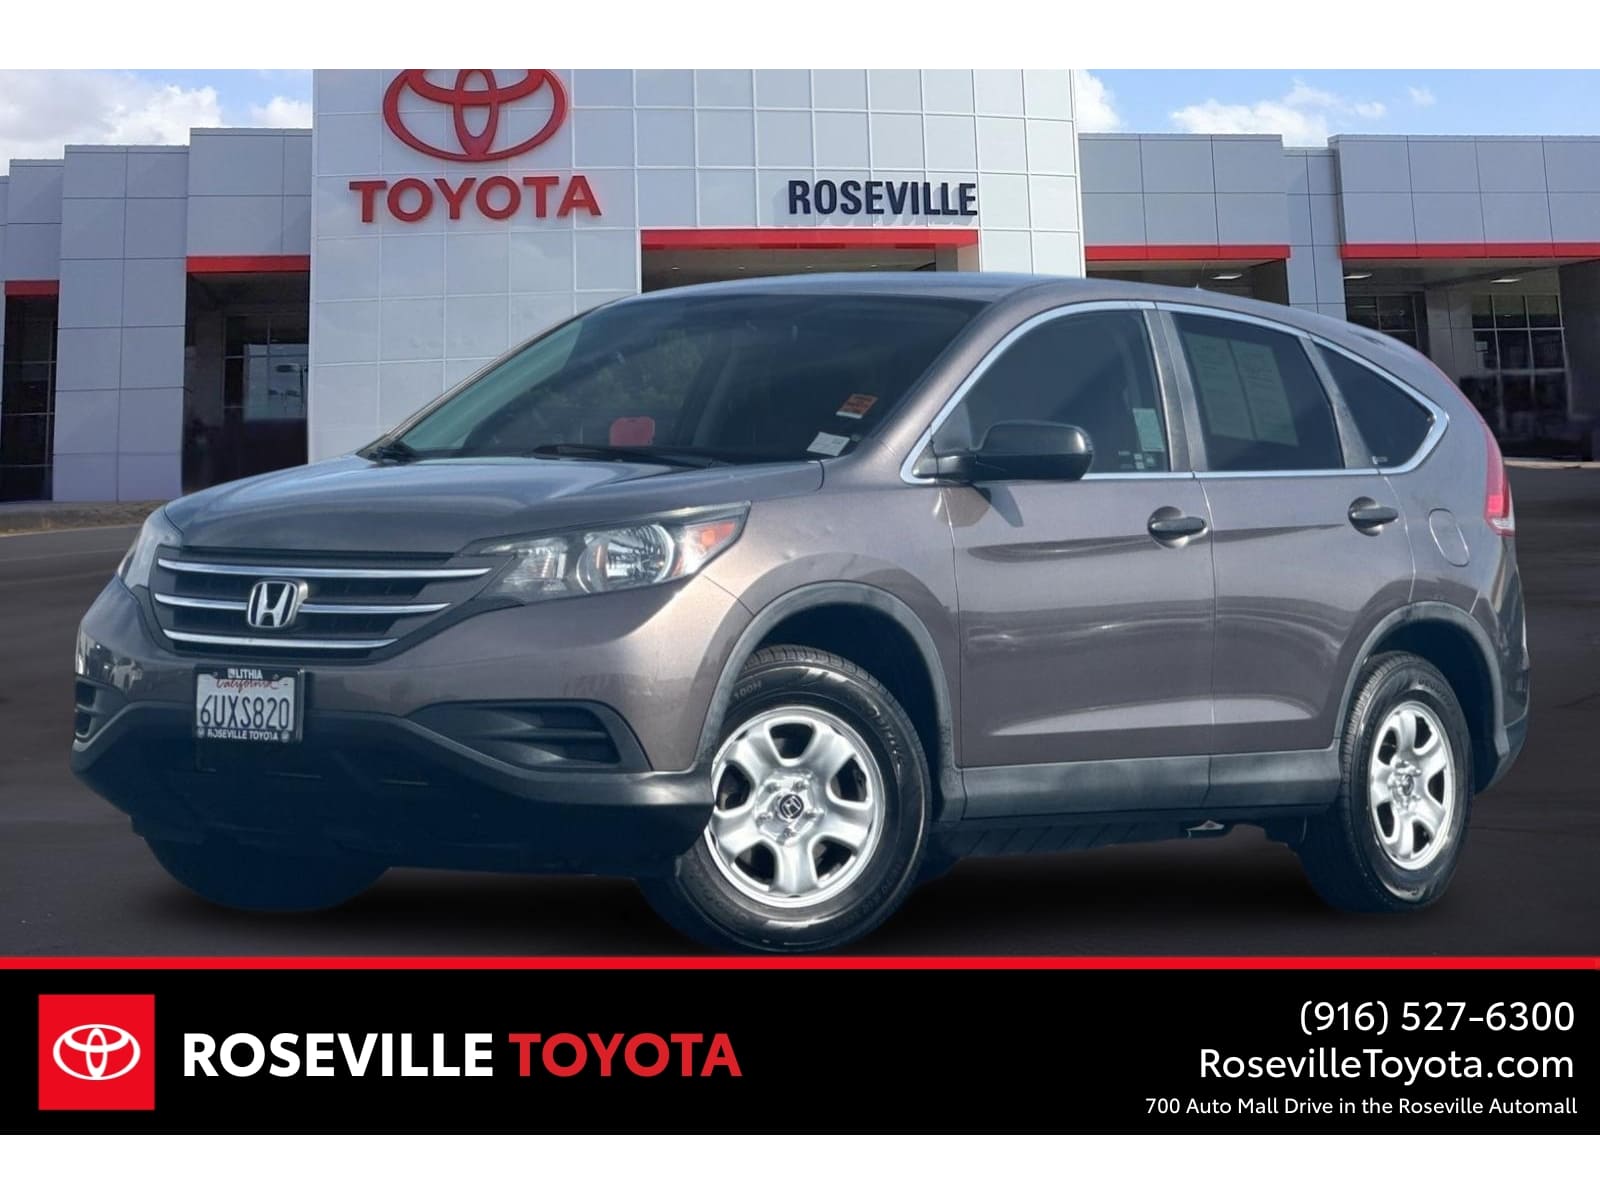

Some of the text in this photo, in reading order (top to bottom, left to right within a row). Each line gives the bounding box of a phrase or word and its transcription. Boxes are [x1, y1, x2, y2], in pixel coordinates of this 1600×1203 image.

[349, 175, 602, 223] TOYOTA
[788, 179, 978, 217] ROSEVILLE
[236, 669, 263, 680] LITHIA
[200, 694, 290, 729] 6UXS820
[207, 728, 279, 741] ROSEVILLE TOYOTA
